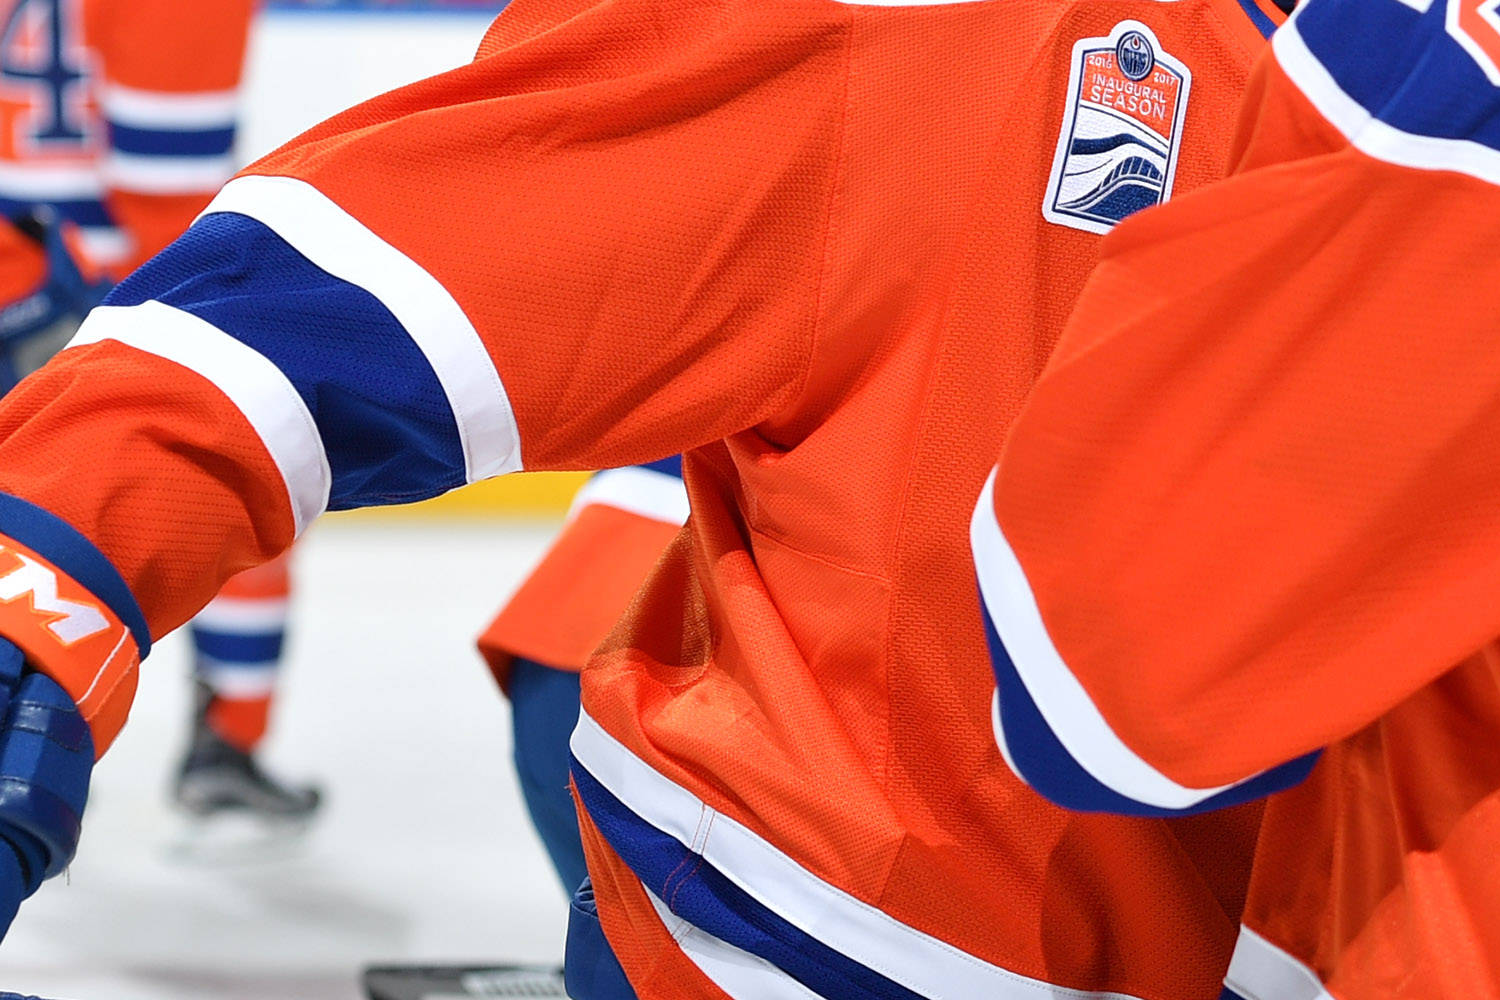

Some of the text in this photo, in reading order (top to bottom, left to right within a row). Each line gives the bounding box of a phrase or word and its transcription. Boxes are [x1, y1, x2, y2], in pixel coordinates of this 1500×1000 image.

[1088, 54, 1113, 69] 2016
[1153, 71, 1176, 87] 2017
[1090, 85, 1167, 120] SEASON
[1092, 73, 1167, 104] INAUGURAL
